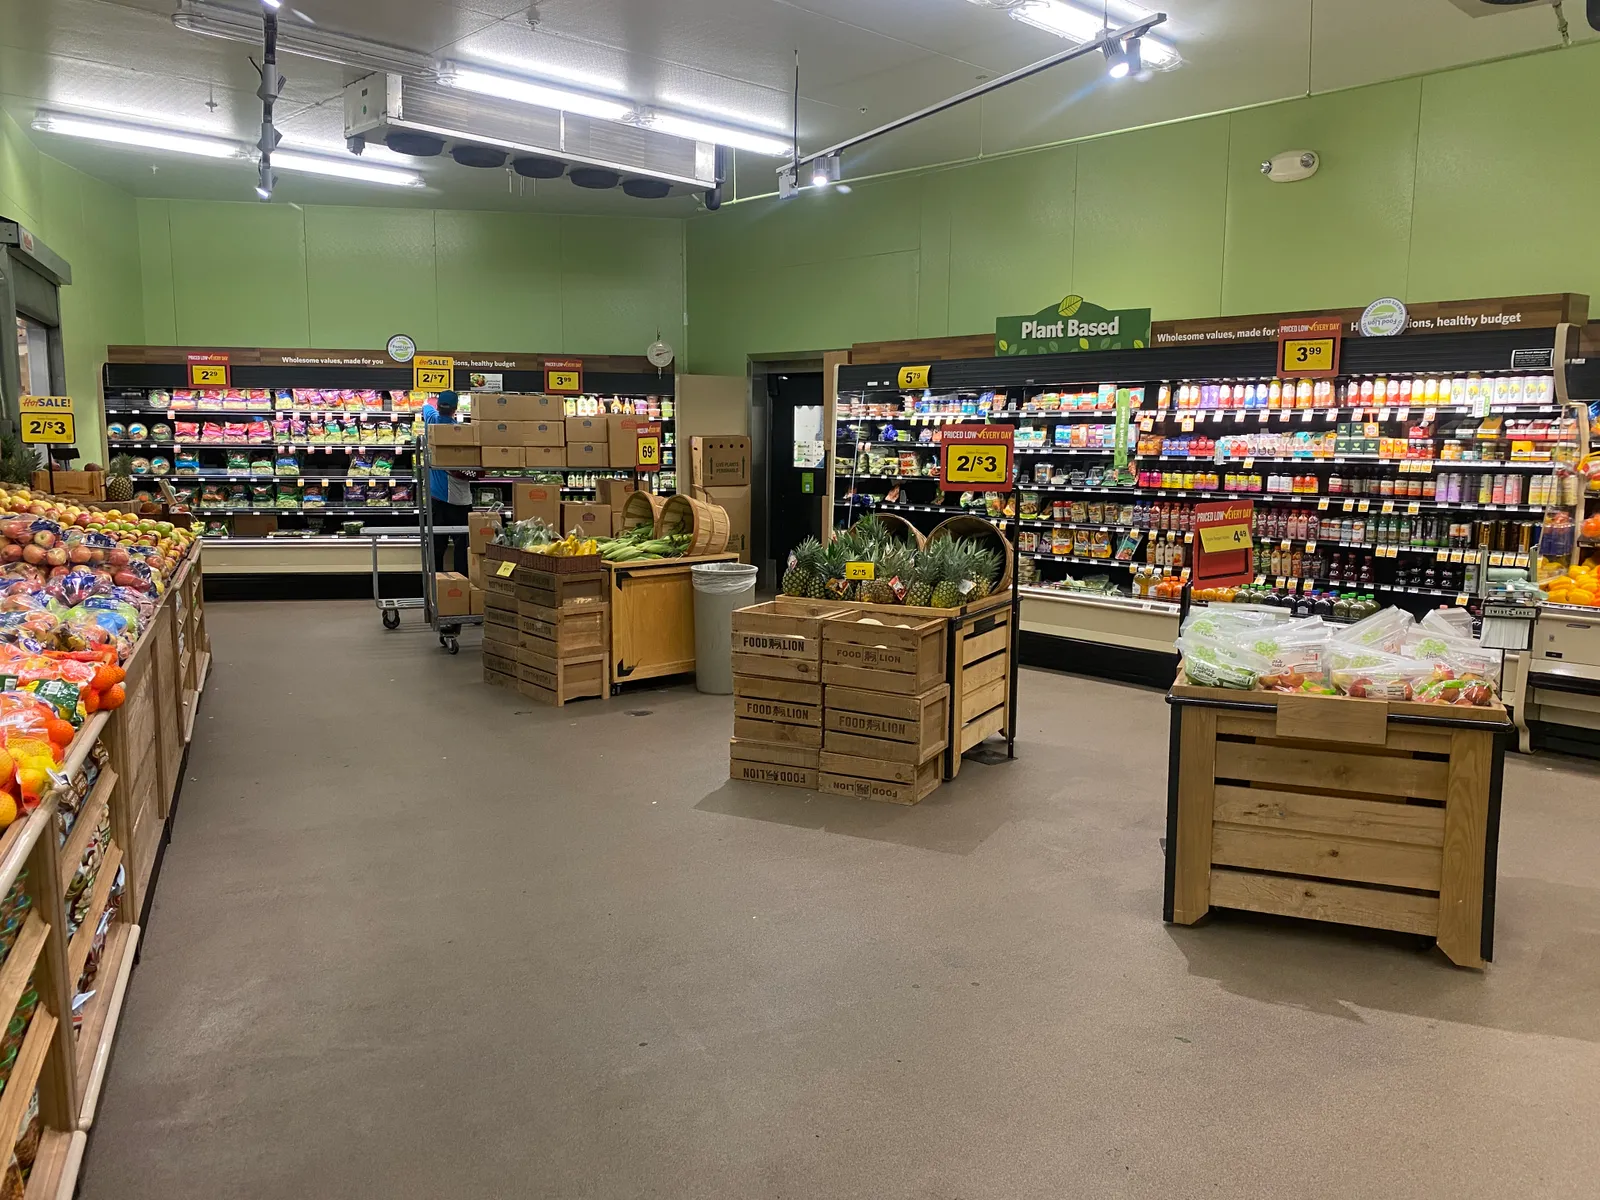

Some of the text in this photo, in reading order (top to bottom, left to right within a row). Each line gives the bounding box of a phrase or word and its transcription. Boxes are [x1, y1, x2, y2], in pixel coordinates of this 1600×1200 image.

[1021, 316, 1120, 339] Plant Based
[1367, 319, 1381, 327] Lion
[1407, 312, 1521, 330] ions, healthy budget
[1157, 332, 1205, 343] Wholesome
[1206, 331, 1235, 340] values,
[1237, 329, 1260, 338] made
[1262, 327, 1275, 336] for
[1281, 325, 1297, 333] PRICED
[320, 357, 343, 365] values,
[470, 360, 493, 368] healthy
[494, 360, 516, 368] budget
[422, 373, 445, 383] 2/$7
[23, 398, 71, 408] Hot SALE!
[30, 421, 66, 435] 2/$3
[943, 430, 1012, 439] PRICED LOW EVERY DAY
[642, 445, 655, 458] 69¢
[956, 455, 997, 472] 2/$3
[1197, 508, 1252, 523] PRICED LOW EVERY DAY
[743, 636, 805, 652] FOOD LION
[836, 649, 901, 664] FOOD LION
[746, 703, 809, 720] FOOD LION
[838, 715, 905, 735] FOOD LION
[743, 767, 806, 784] FOOD LION
[833, 781, 898, 798] FOOD LION
